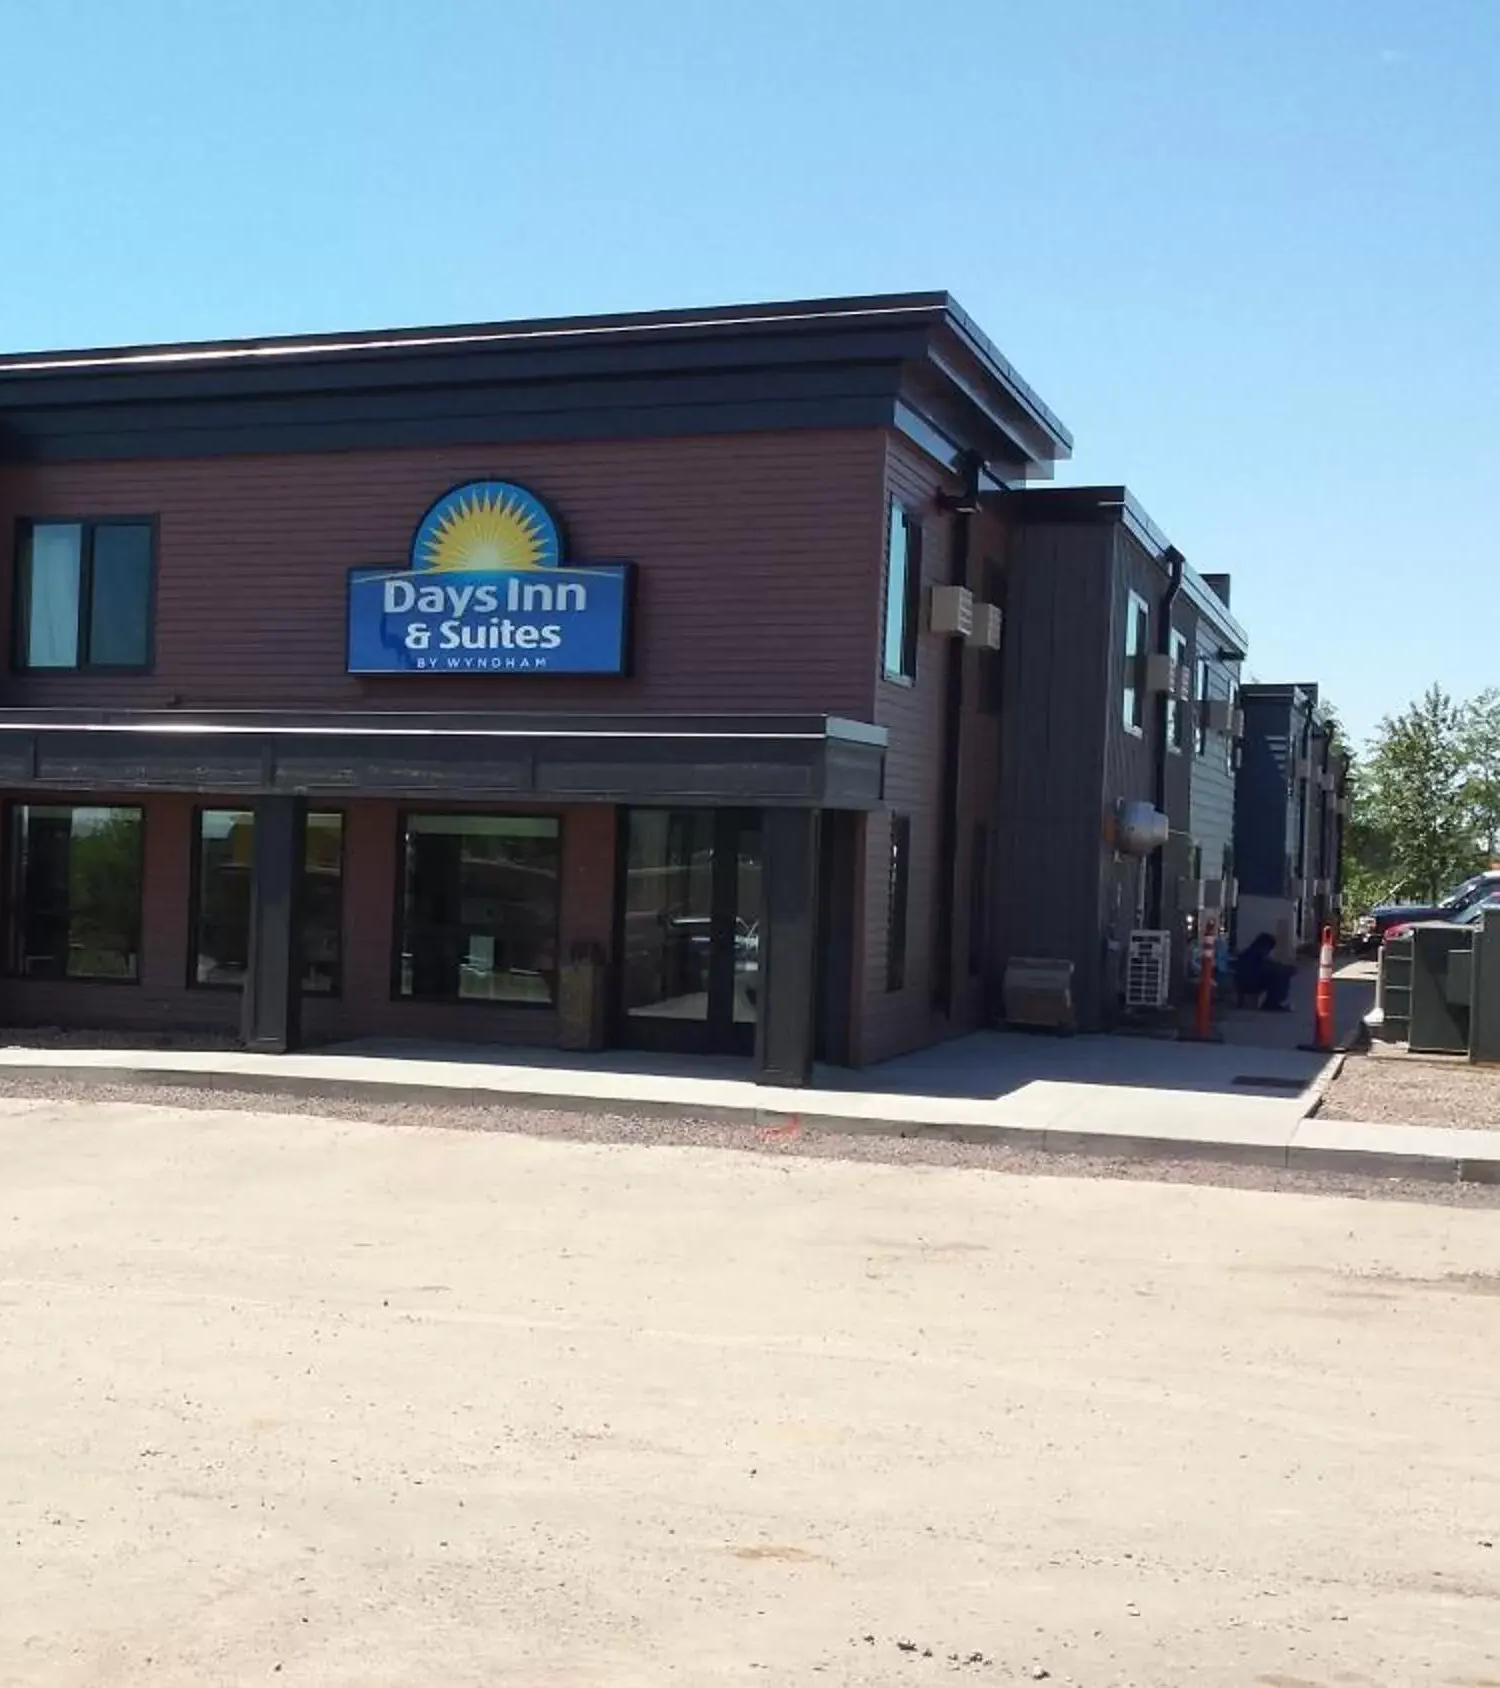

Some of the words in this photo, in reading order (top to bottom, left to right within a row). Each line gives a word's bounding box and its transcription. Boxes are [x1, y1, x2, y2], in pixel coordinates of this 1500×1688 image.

[383, 579, 498, 617] Days
[507, 578, 587, 612] Inn
[404, 622, 431, 649] &
[439, 618, 562, 650] Suites
[416, 657, 438, 669] BY
[447, 656, 548, 669] WYNDHAM
